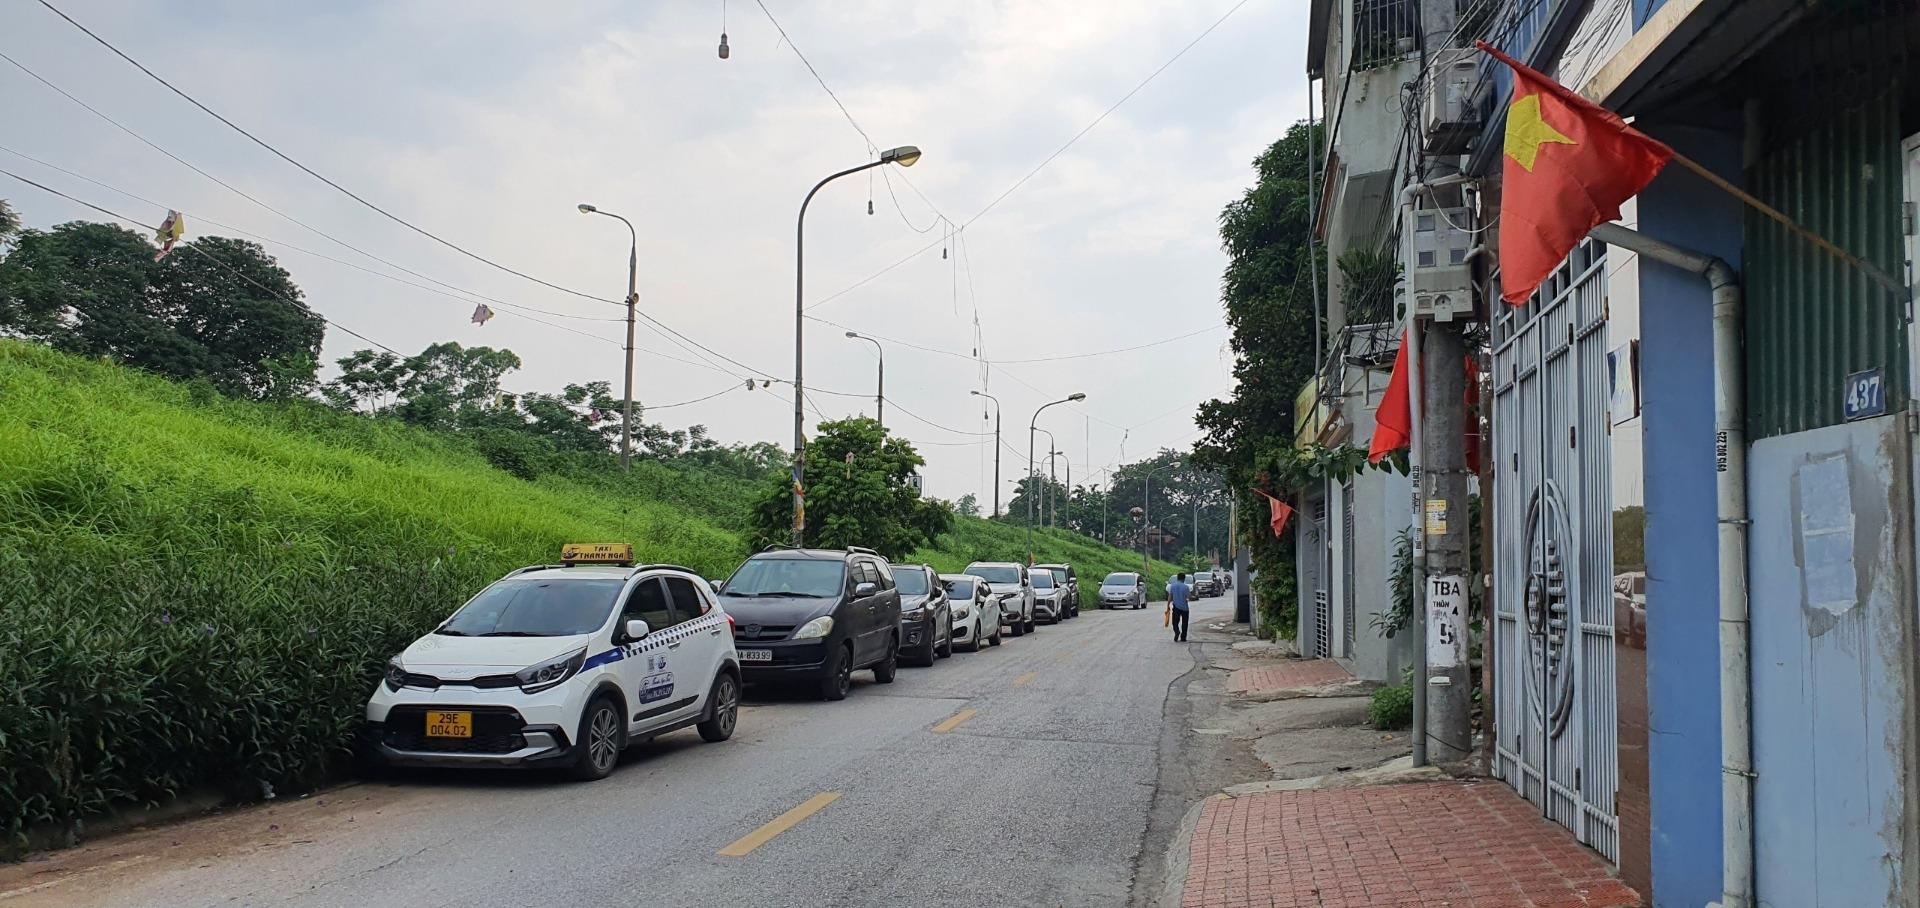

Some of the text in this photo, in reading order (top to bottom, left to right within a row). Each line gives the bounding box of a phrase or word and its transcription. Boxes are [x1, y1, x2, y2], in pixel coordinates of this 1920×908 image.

[1848, 376, 1880, 412] 437
[1432, 581, 1460, 596] TBA
[1440, 623, 1454, 644] 5
[439, 713, 459, 724] 29E
[431, 725, 467, 736] 004.02
